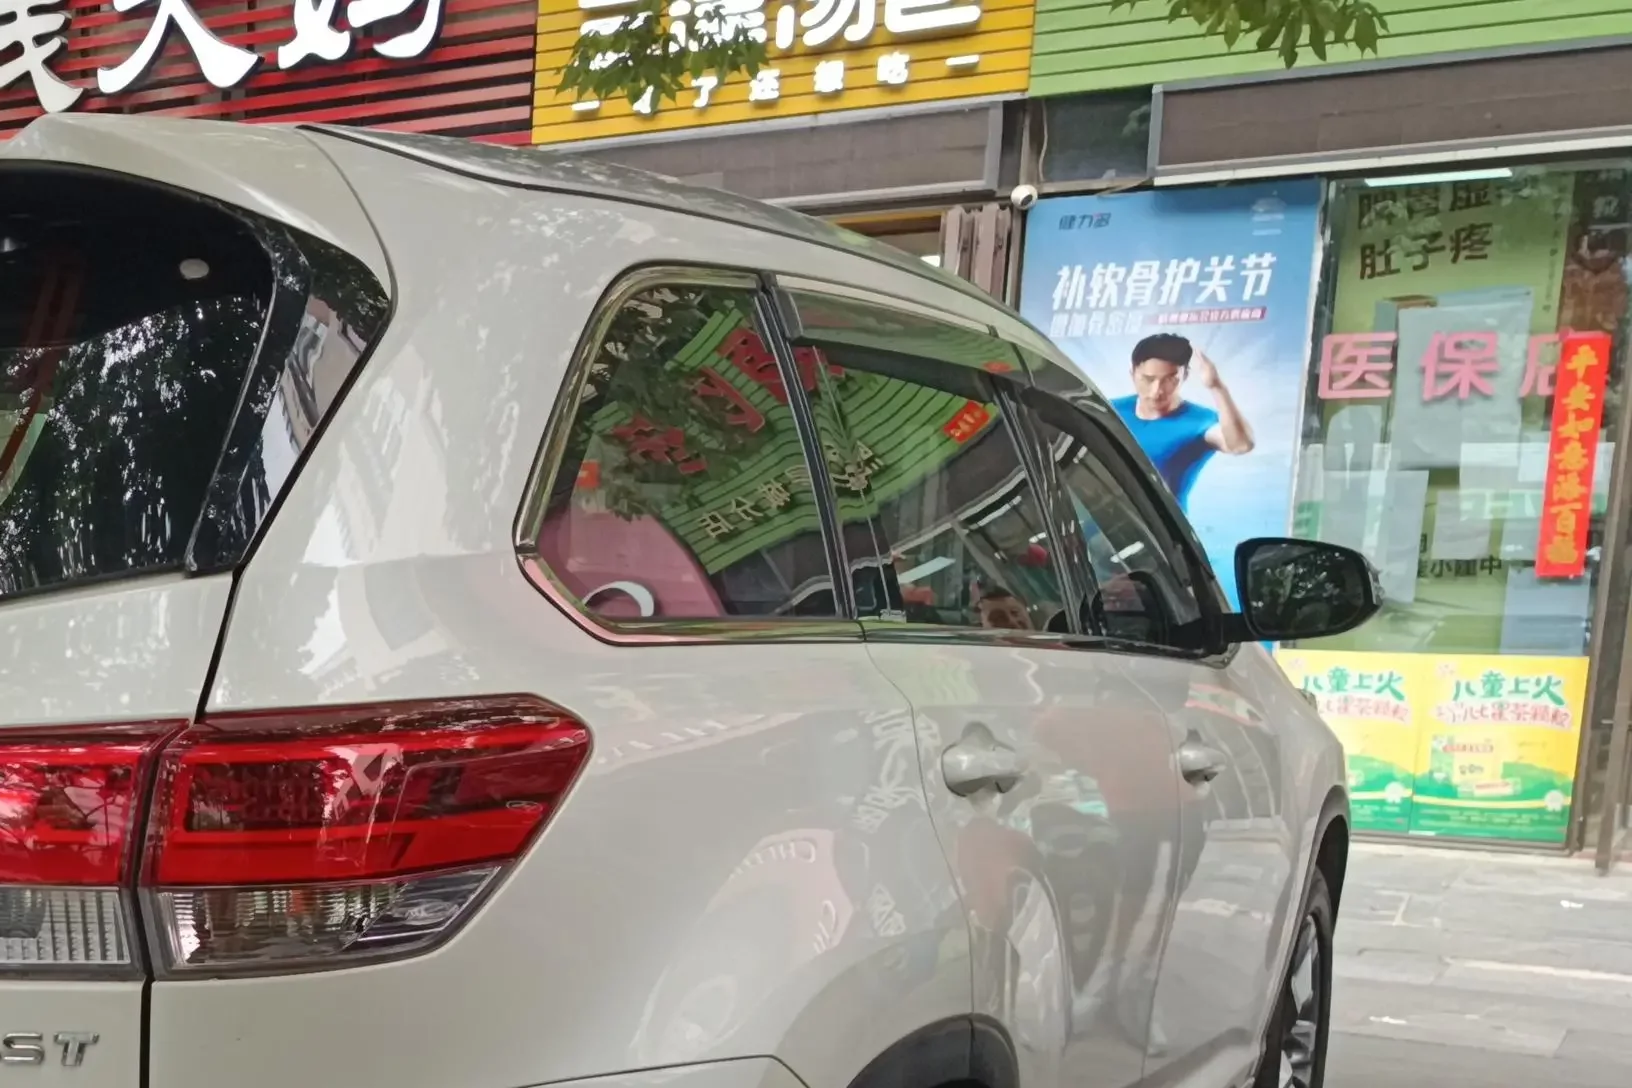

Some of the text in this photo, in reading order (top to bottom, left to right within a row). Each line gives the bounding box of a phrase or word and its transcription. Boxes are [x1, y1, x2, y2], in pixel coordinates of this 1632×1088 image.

[1359, 222, 1494, 280] 肚子疼
[1052, 252, 1276, 311] 补软骨护关节
